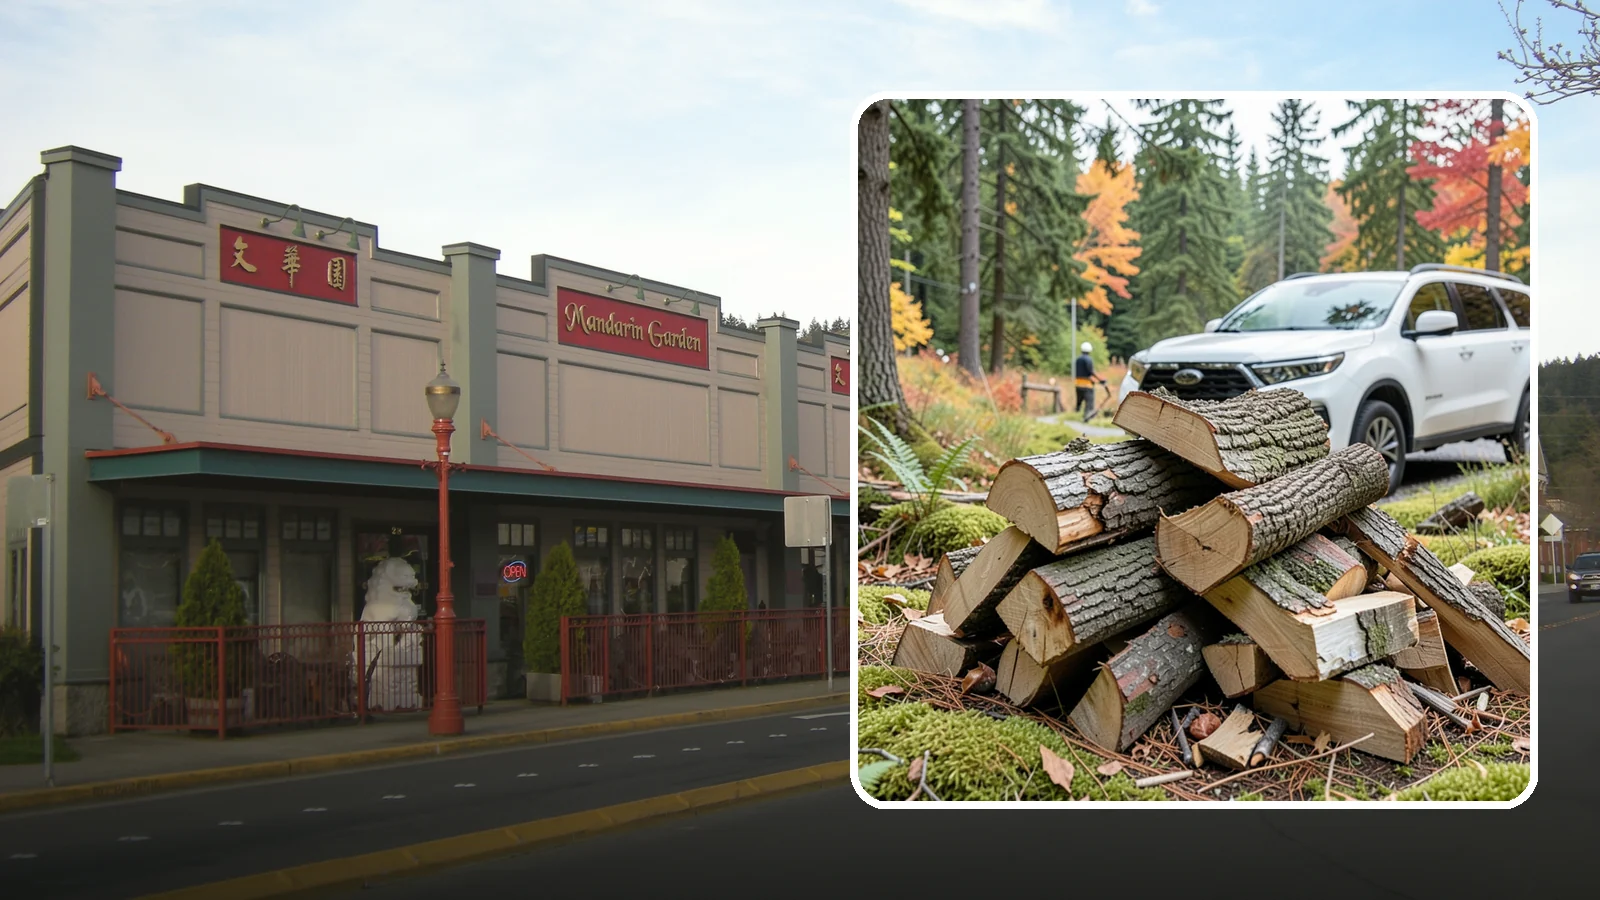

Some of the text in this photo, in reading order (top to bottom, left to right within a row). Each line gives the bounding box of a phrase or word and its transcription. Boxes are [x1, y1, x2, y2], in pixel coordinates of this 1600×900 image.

[564, 302, 702, 353] Mandarin Garden
[503, 565, 527, 578] OPEN
